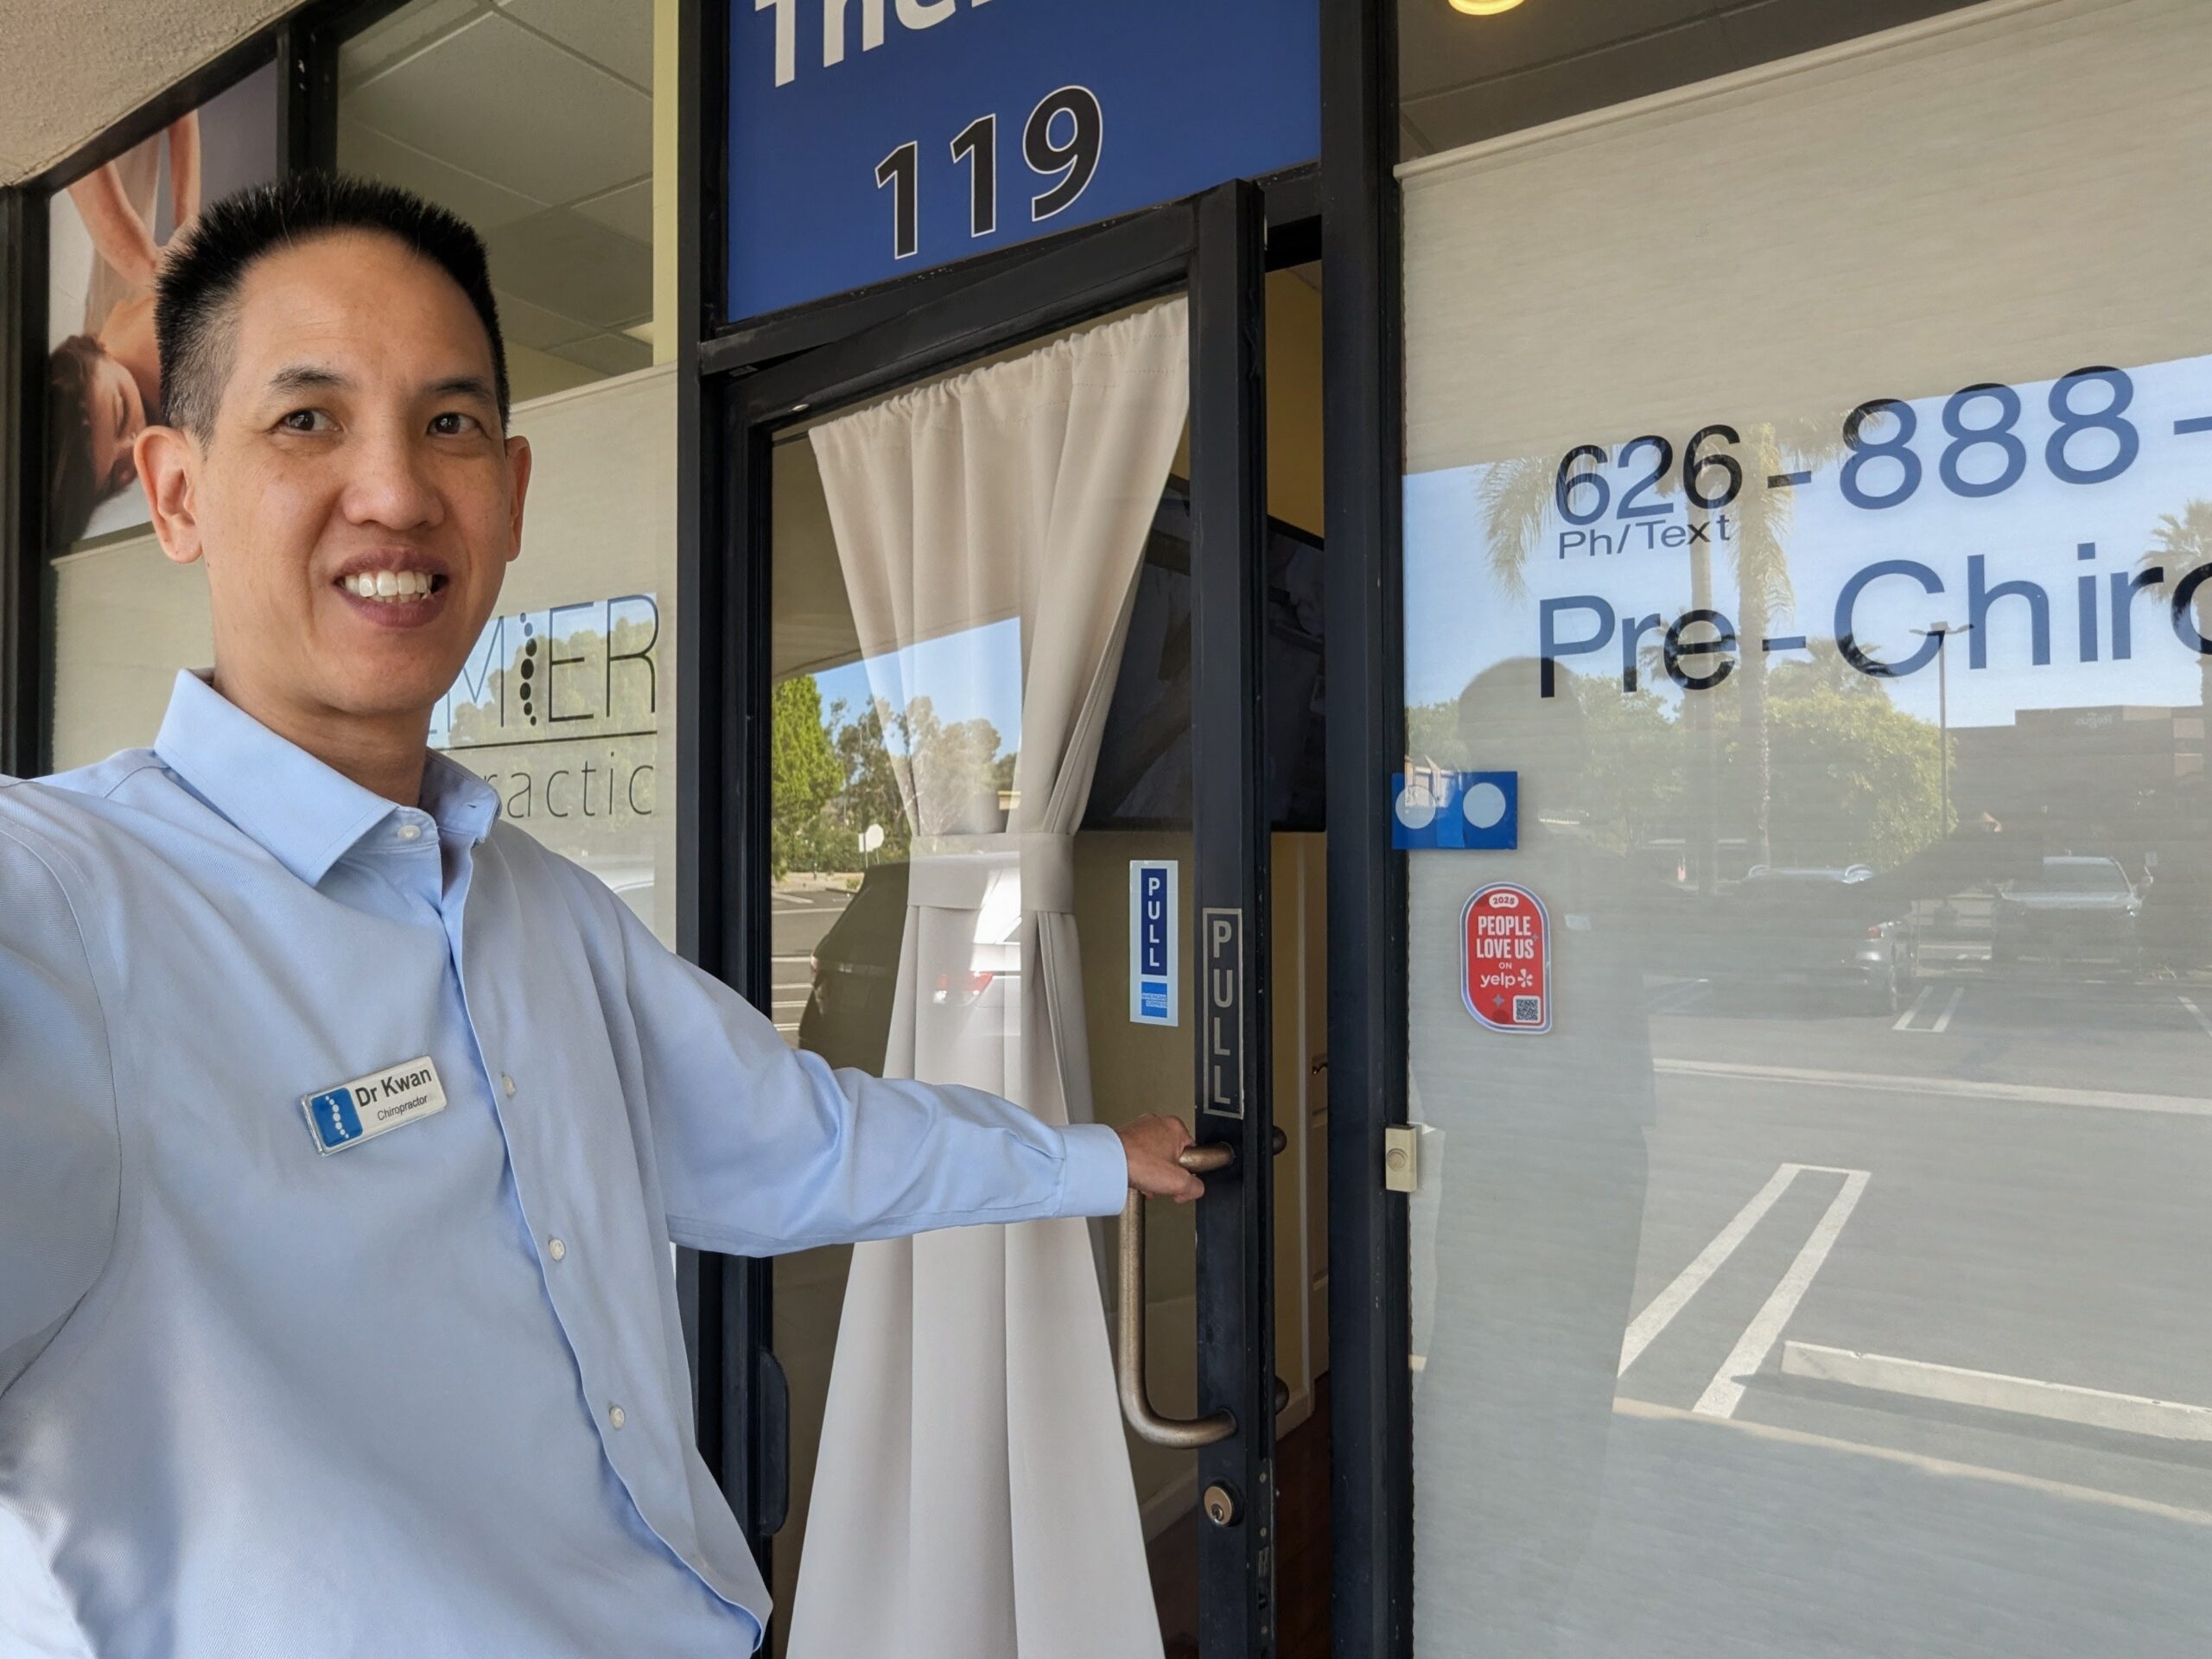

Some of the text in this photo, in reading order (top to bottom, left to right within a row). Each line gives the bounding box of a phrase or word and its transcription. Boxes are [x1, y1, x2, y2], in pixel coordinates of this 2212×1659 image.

[874, 85, 1103, 260] 119
[1558, 514, 1731, 560] Ph/Text
[1147, 877, 1160, 967] PULL
[1478, 915, 1531, 936] PEOPLE
[1476, 938, 1535, 959] LOVE US
[1480, 971, 1516, 988] yelp
[1212, 920, 1234, 1104] PULL
[355, 1069, 432, 1107] Dr Kwan
[377, 1095, 428, 1121] Chiropractor
